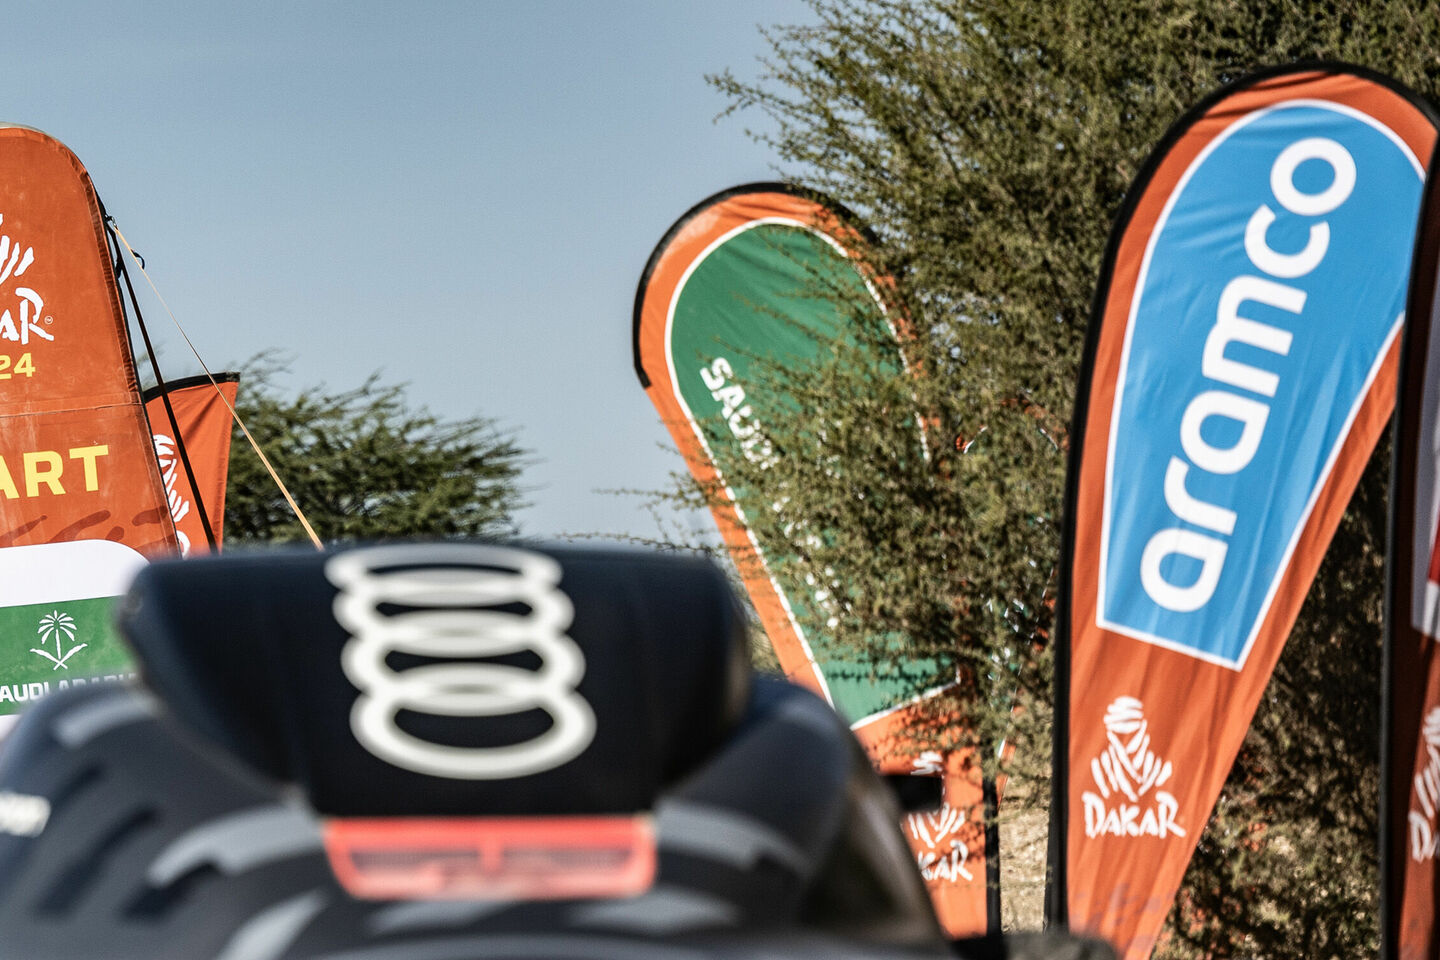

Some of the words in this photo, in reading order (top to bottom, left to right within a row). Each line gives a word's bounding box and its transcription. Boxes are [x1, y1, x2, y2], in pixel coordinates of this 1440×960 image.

[1140, 137, 1357, 613] aramco
[1082, 790, 1186, 839] DAKAR
[917, 839, 973, 883] KAR
